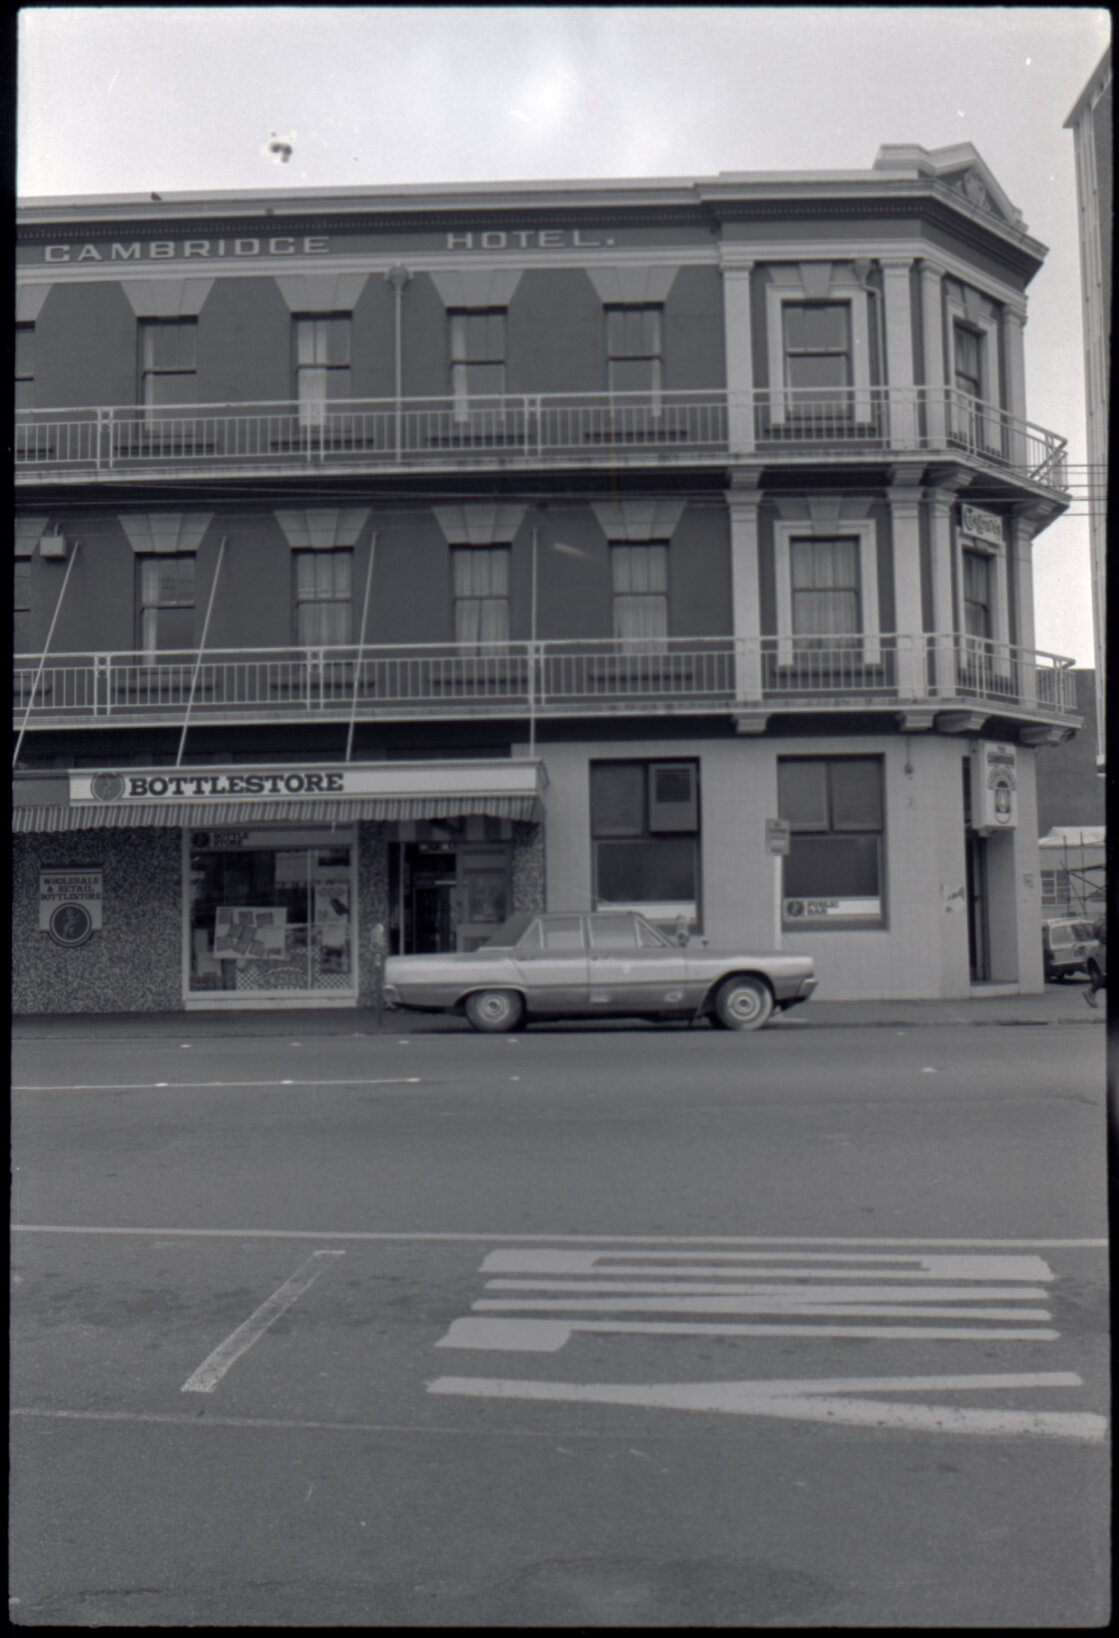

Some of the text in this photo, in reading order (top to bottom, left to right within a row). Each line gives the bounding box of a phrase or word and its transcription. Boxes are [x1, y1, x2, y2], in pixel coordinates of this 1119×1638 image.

[44, 229, 616, 263] CAMBRIDGE HOTEL.
[130, 773, 344, 797] BOTTLESTORE
[43, 876, 100, 885] WHOLESALE
[58, 885, 95, 893] RETAIL
